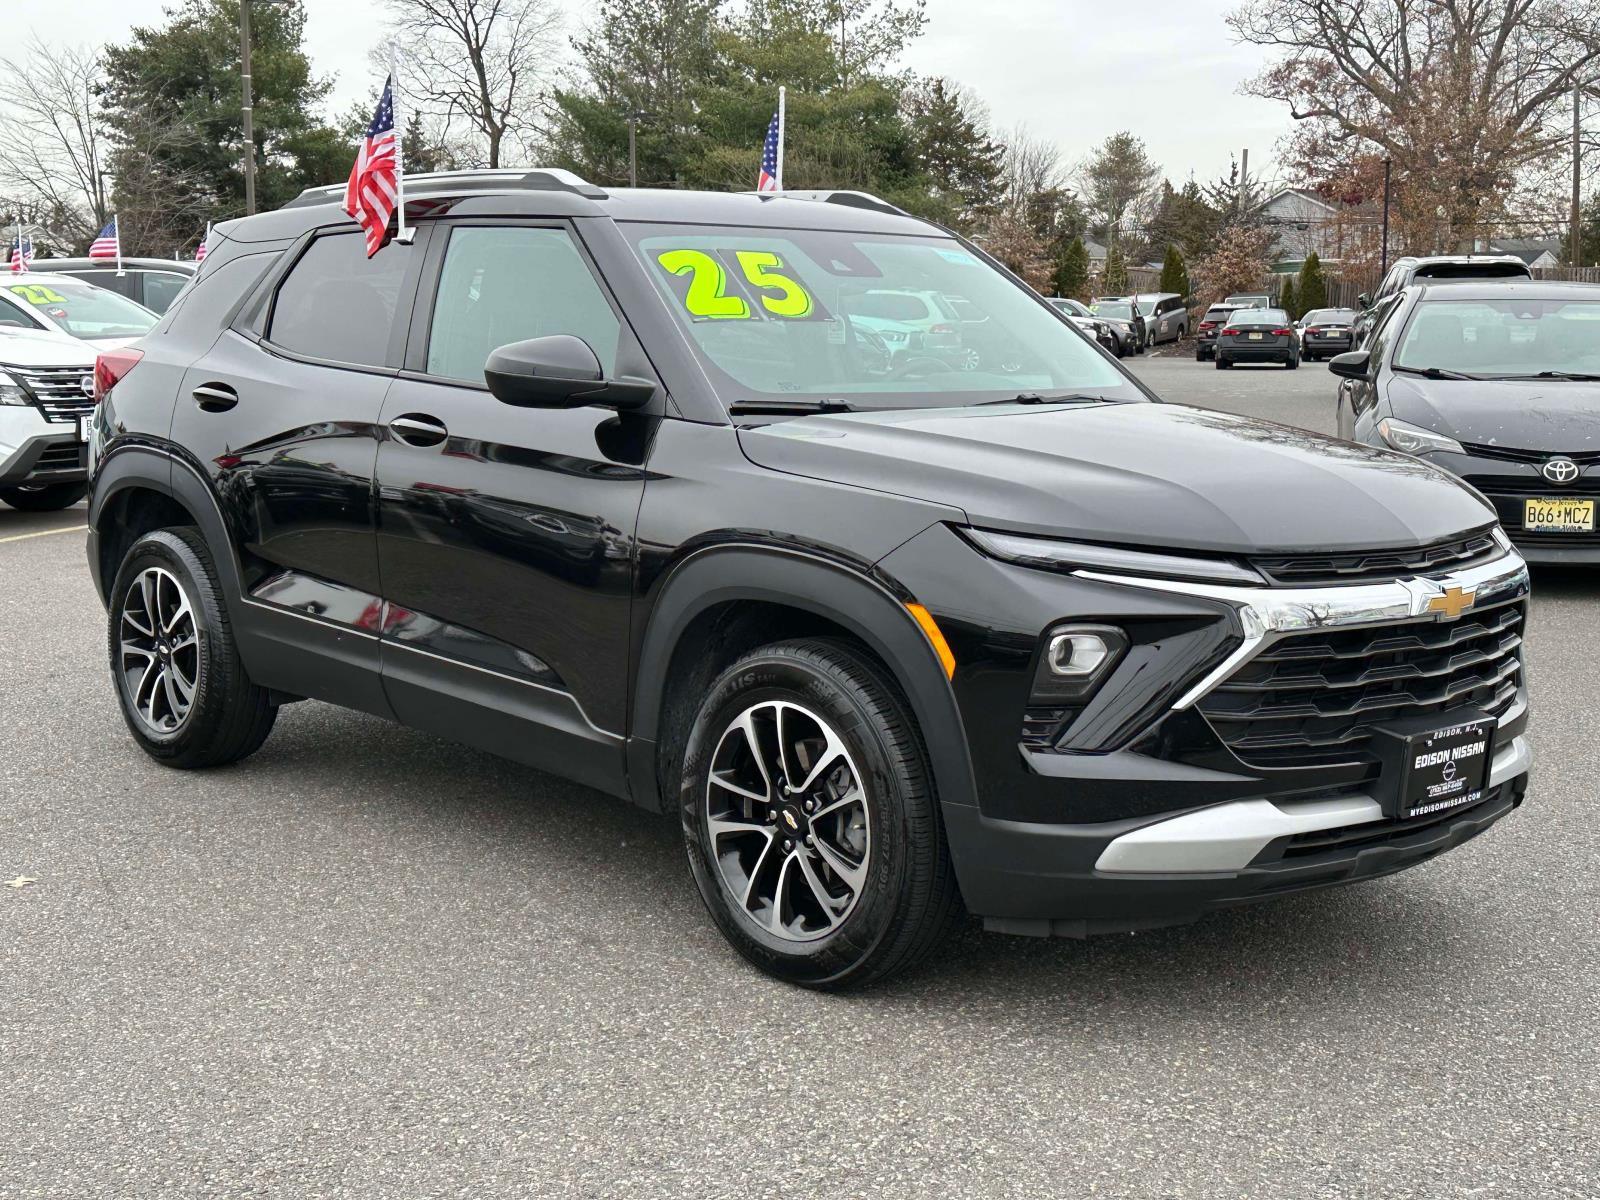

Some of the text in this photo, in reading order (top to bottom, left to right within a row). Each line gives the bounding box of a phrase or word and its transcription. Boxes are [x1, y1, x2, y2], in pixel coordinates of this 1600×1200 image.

[658, 249, 814, 318] 25
[9, 285, 68, 305] 22
[1528, 507, 1590, 523] B66 MCZ
[1433, 729, 1463, 739] EDISON,
[1415, 741, 1485, 769] EDISON NISSAN
[1410, 792, 1481, 816] MYEDISONNISSAN.COM
